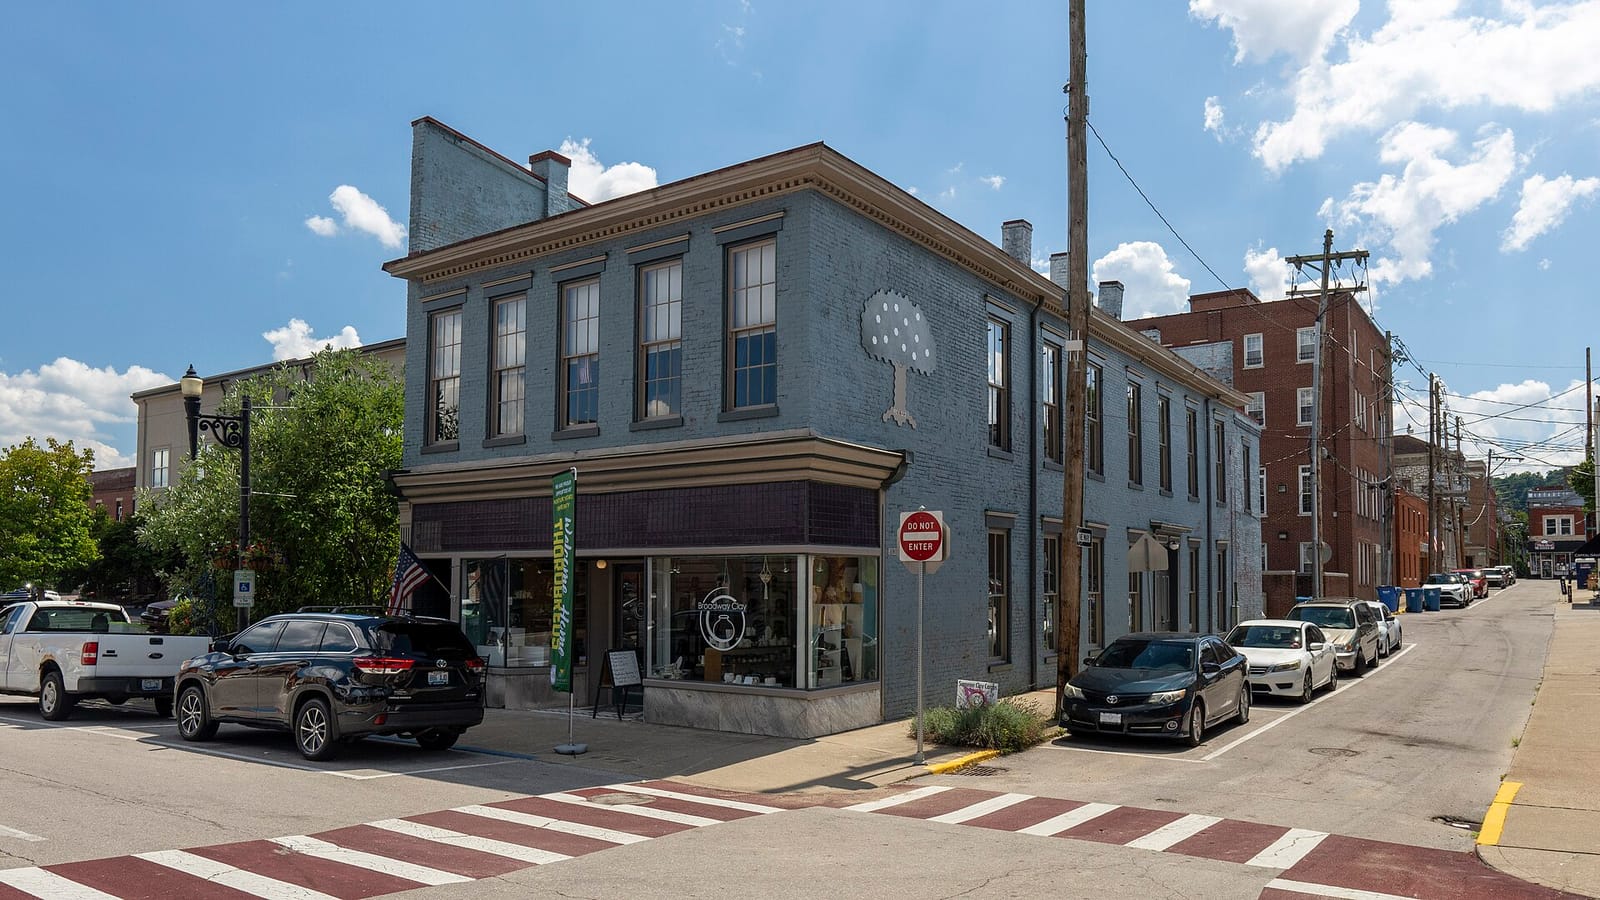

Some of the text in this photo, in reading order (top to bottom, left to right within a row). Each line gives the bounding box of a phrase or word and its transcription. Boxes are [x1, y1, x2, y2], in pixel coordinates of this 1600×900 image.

[908, 522, 934, 530] DO NOT
[562, 517, 573, 594] Welcome
[698, 602, 747, 611] Broadway Clay
[558, 605, 570, 657] Home
